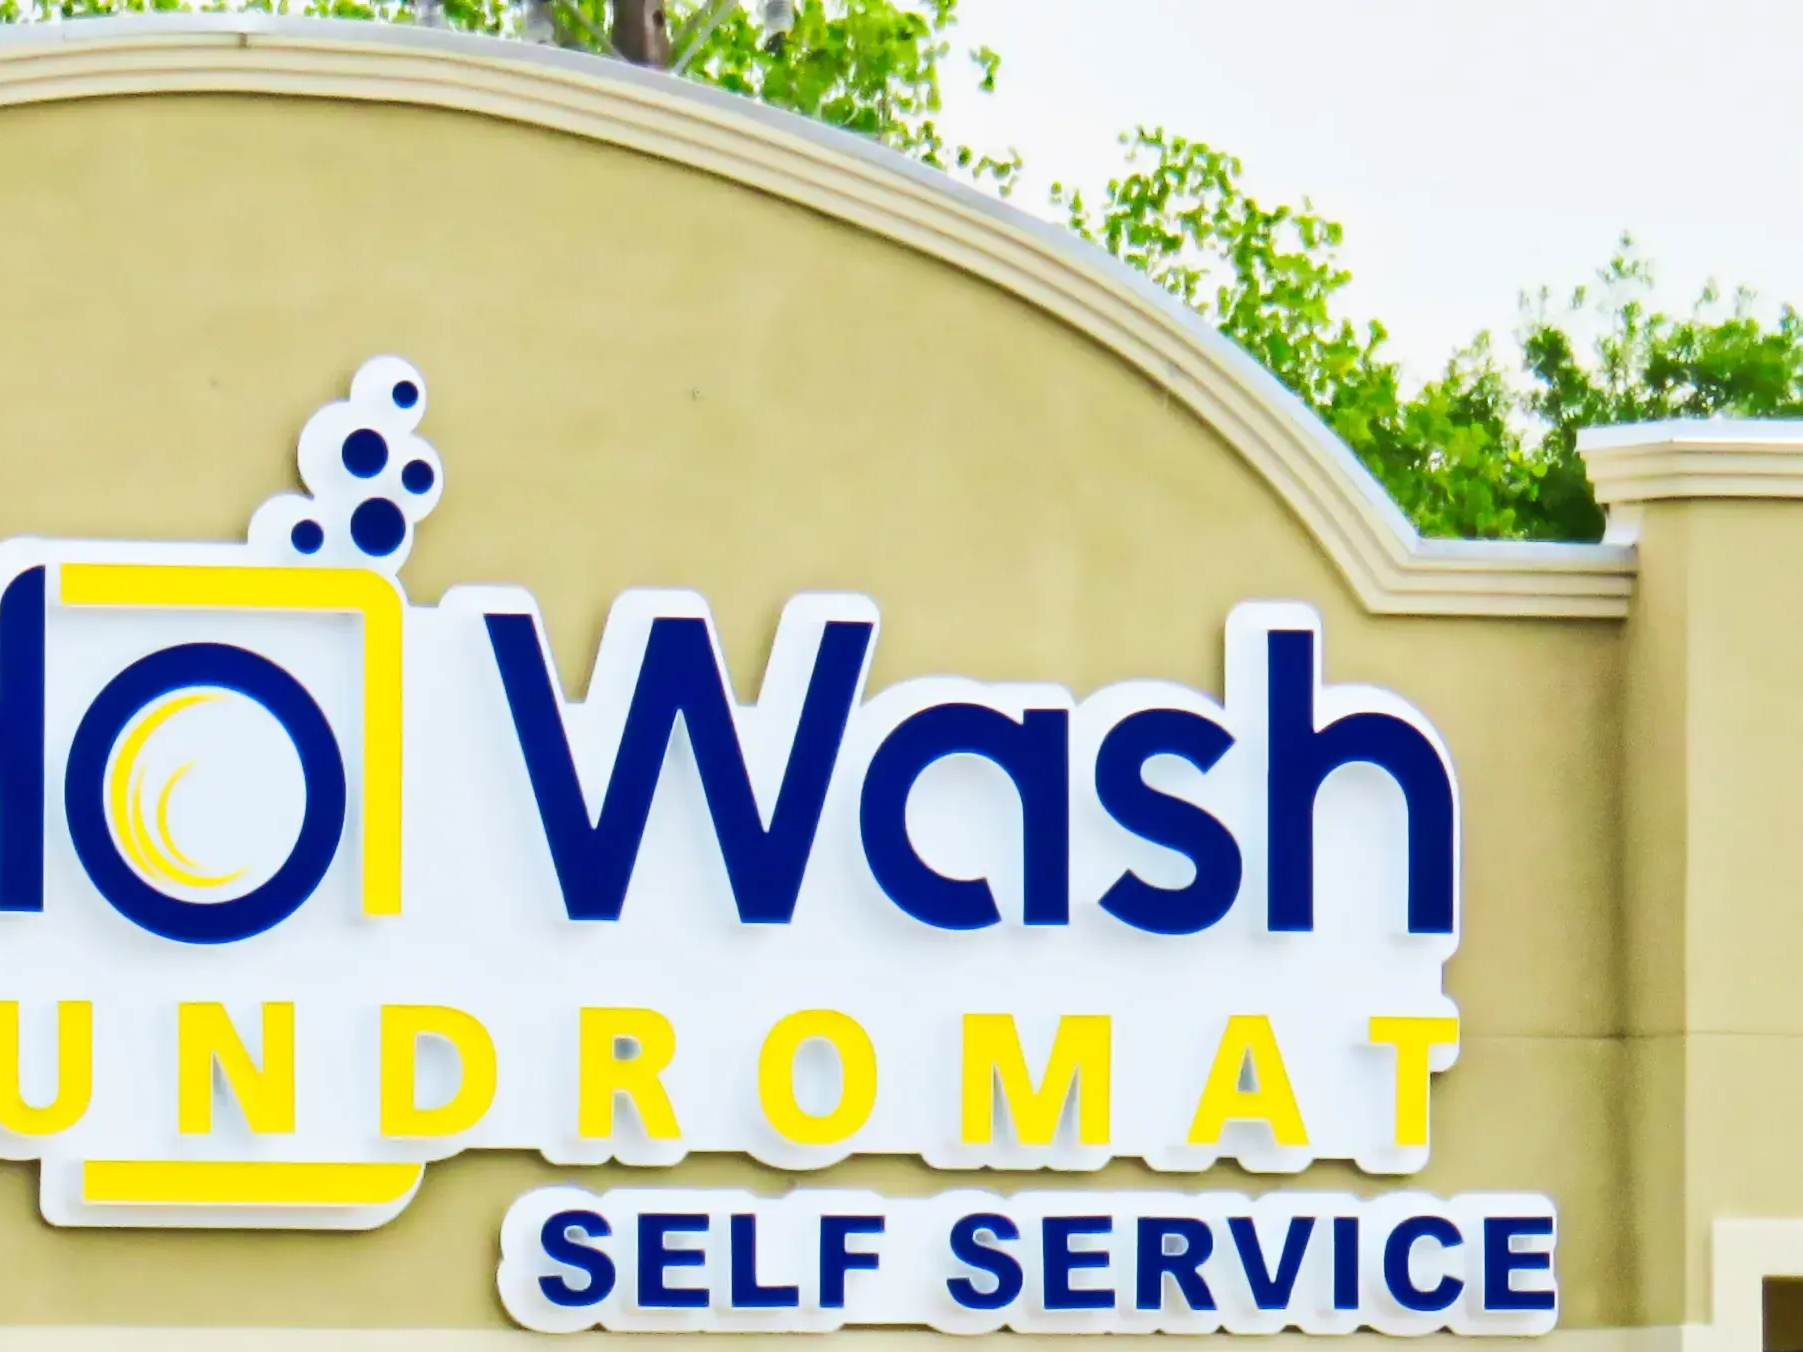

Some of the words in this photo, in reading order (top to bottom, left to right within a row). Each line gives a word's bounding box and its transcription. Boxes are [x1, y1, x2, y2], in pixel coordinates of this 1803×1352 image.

[483, 613, 1455, 936] Wash
[537, 1210, 886, 1309] SELF
[945, 1213, 1557, 1312] SERVICE
